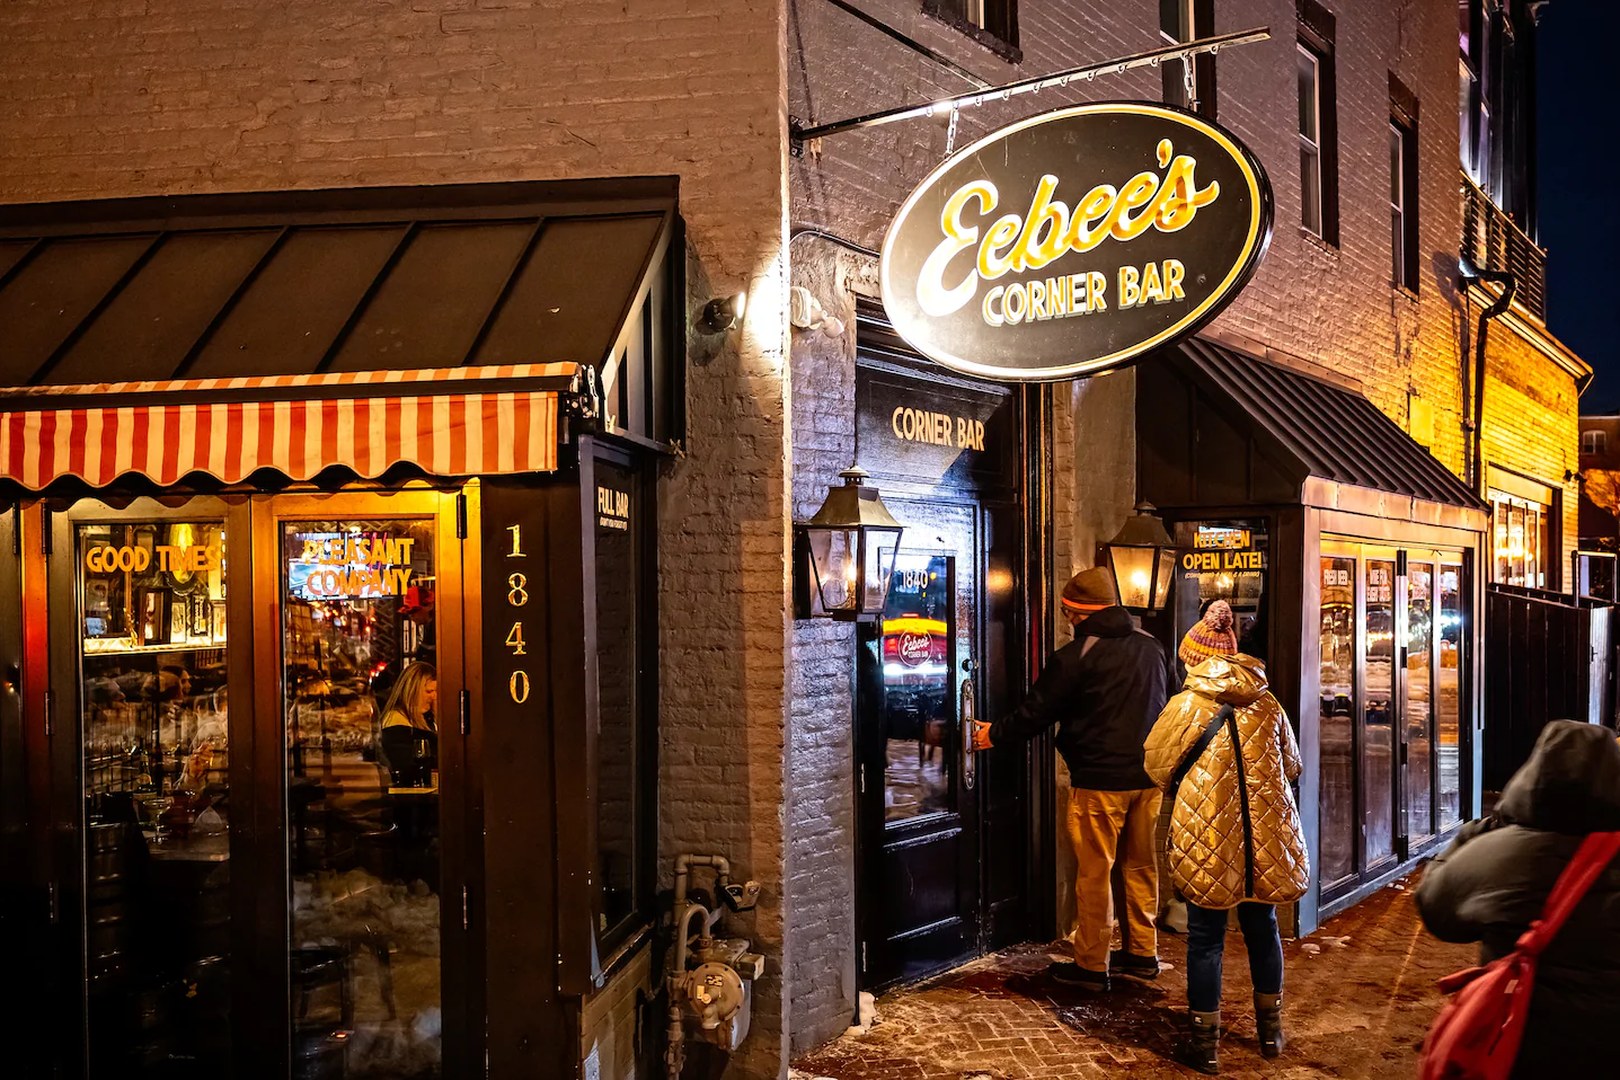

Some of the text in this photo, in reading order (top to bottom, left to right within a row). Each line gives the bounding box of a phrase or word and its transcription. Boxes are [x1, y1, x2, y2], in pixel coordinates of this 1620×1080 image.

[916, 138, 1221, 317] Eebee's
[982, 258, 1186, 327] CORNER BAR
[892, 406, 985, 451] CORNER BAR
[598, 486, 629, 519] FULL BAR
[303, 538, 414, 565] PLEASANT
[1193, 530, 1251, 549] KITCHEN
[86, 545, 219, 573] GOOD TIMES
[1183, 551, 1262, 570] OPEN LATE!
[307, 569, 412, 596] COMPANY
[902, 569, 928, 589] 1840
[505, 523, 530, 704] 1840
